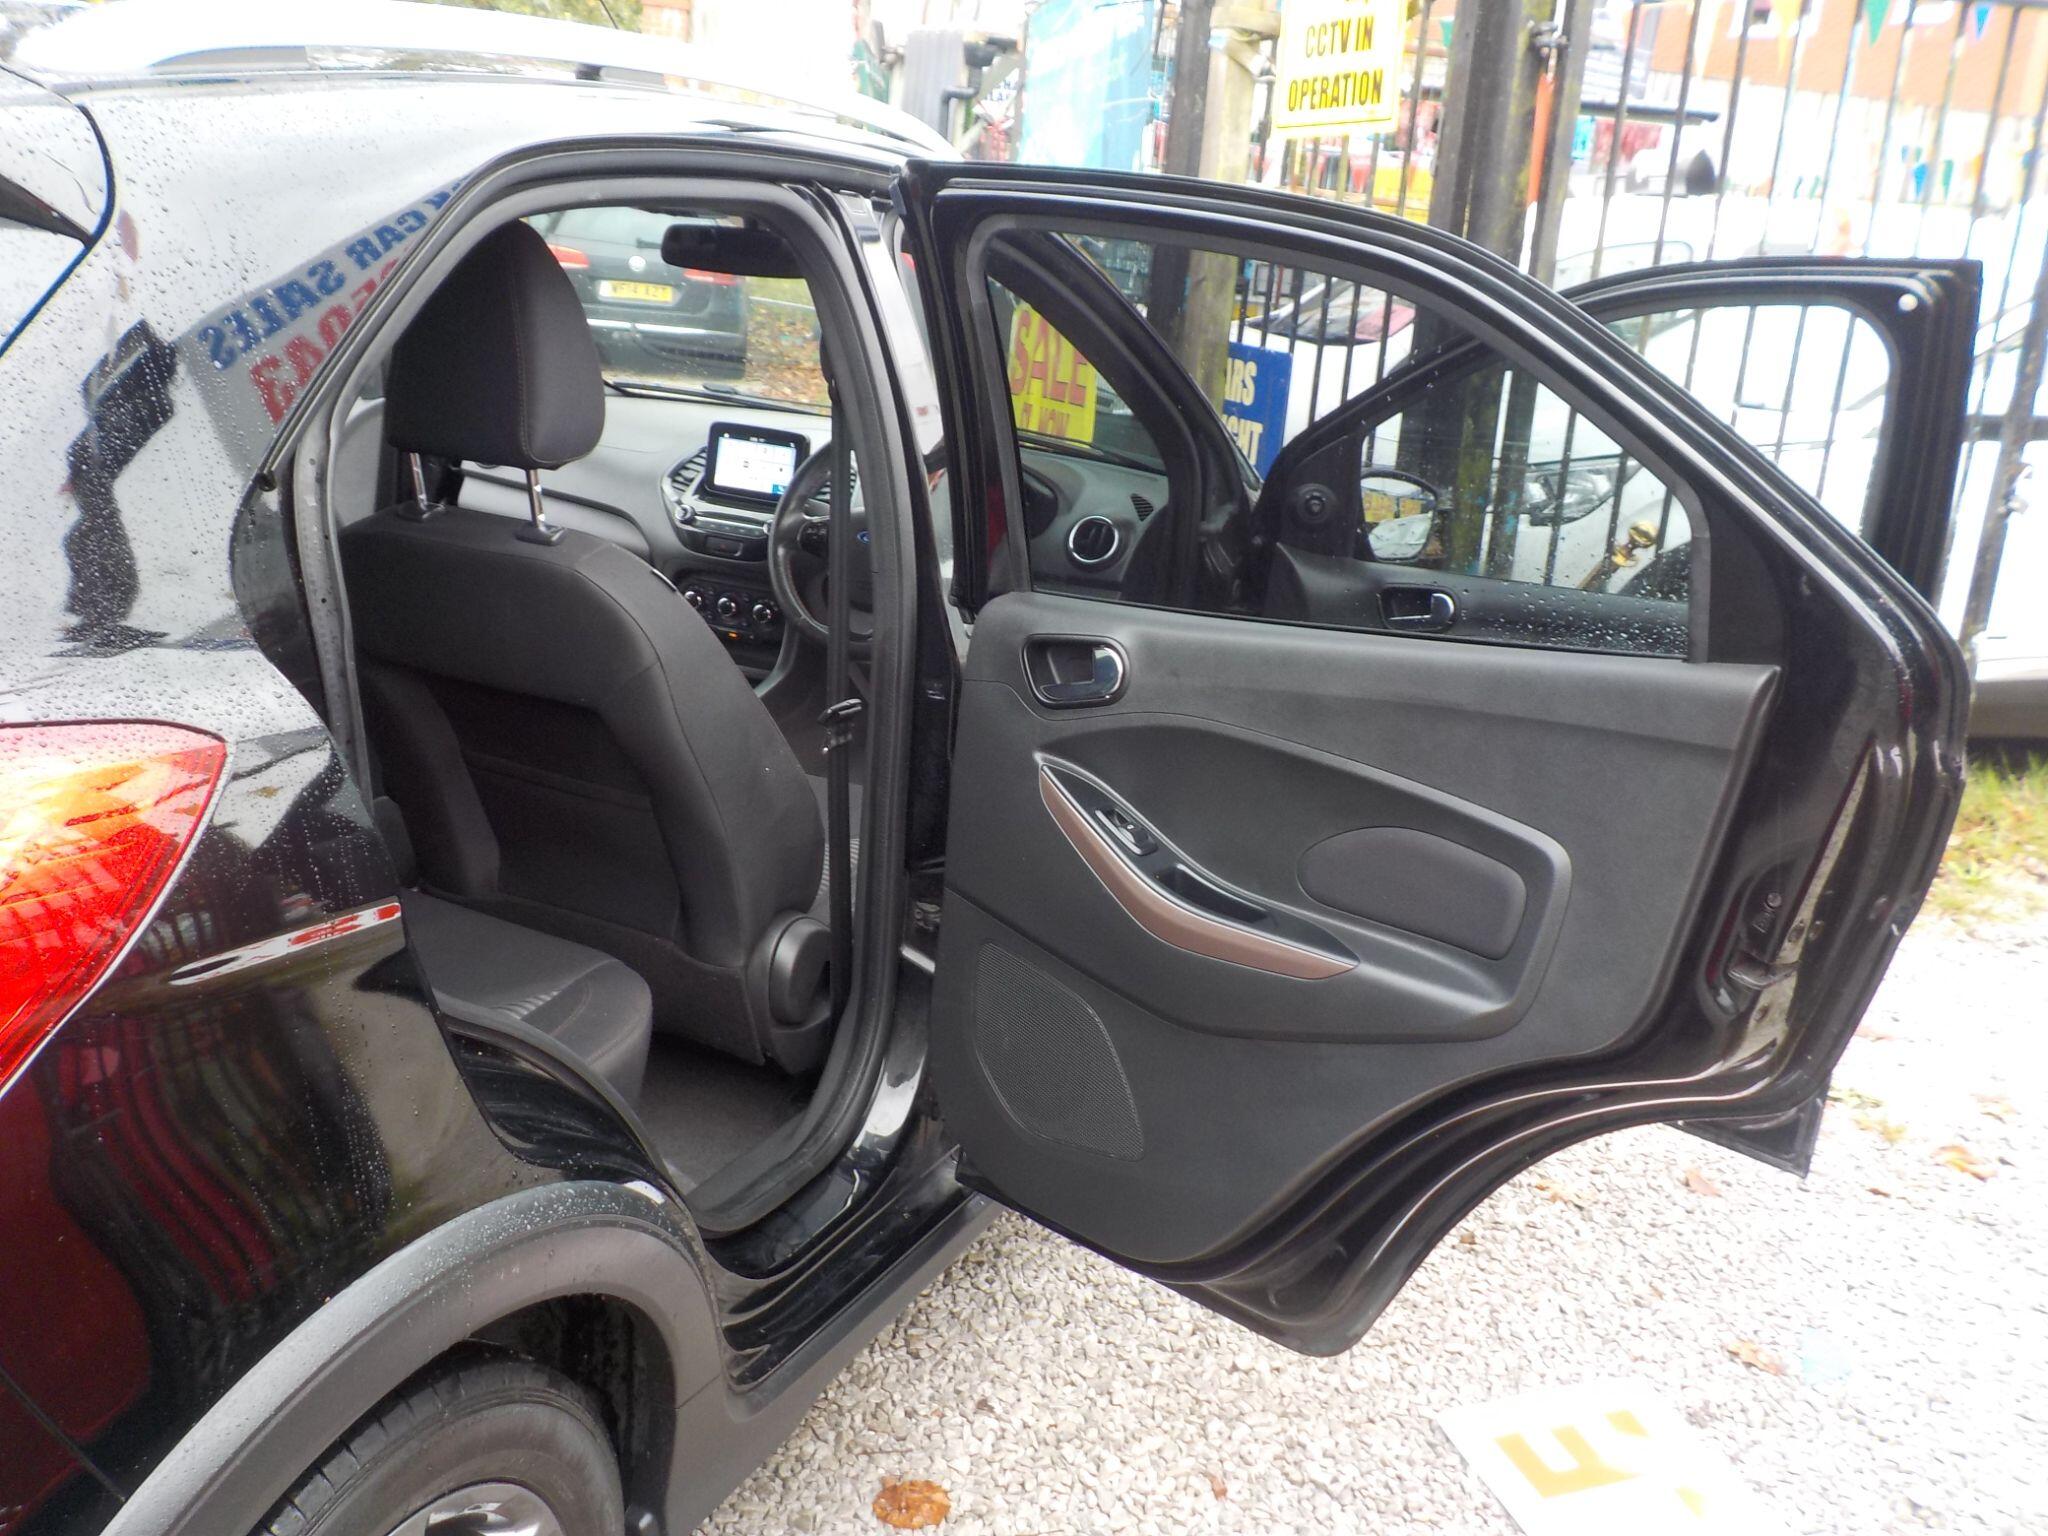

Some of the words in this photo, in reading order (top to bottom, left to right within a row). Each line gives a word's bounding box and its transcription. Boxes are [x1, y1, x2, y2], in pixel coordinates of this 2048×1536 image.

[1305, 18, 1351, 58] CCTV
[1355, 15, 1375, 52] IN
[1288, 67, 1384, 112] OPERATION
[1009, 309, 1089, 408] SALE
